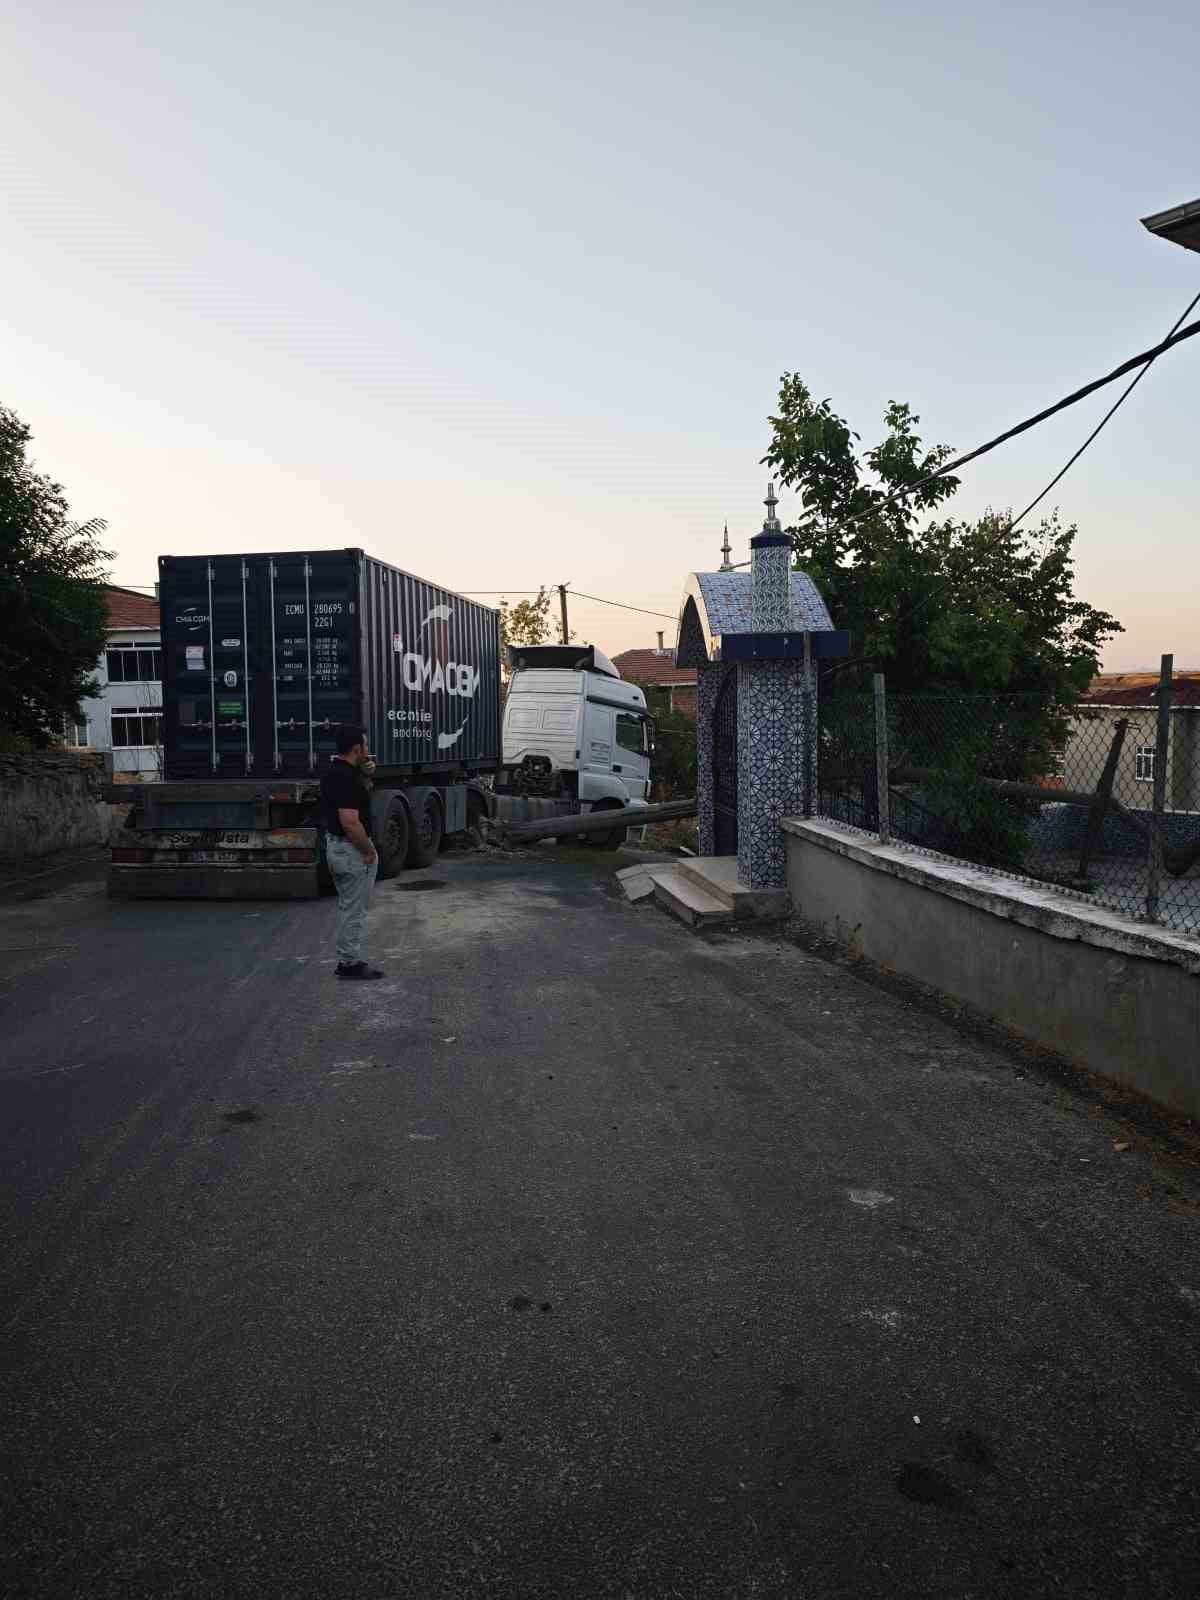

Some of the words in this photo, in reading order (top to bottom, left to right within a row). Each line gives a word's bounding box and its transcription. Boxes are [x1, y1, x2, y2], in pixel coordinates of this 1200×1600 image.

[285, 604, 305, 615] ECMU
[314, 603, 342, 614] 280695
[314, 616, 333, 627] 22G1
